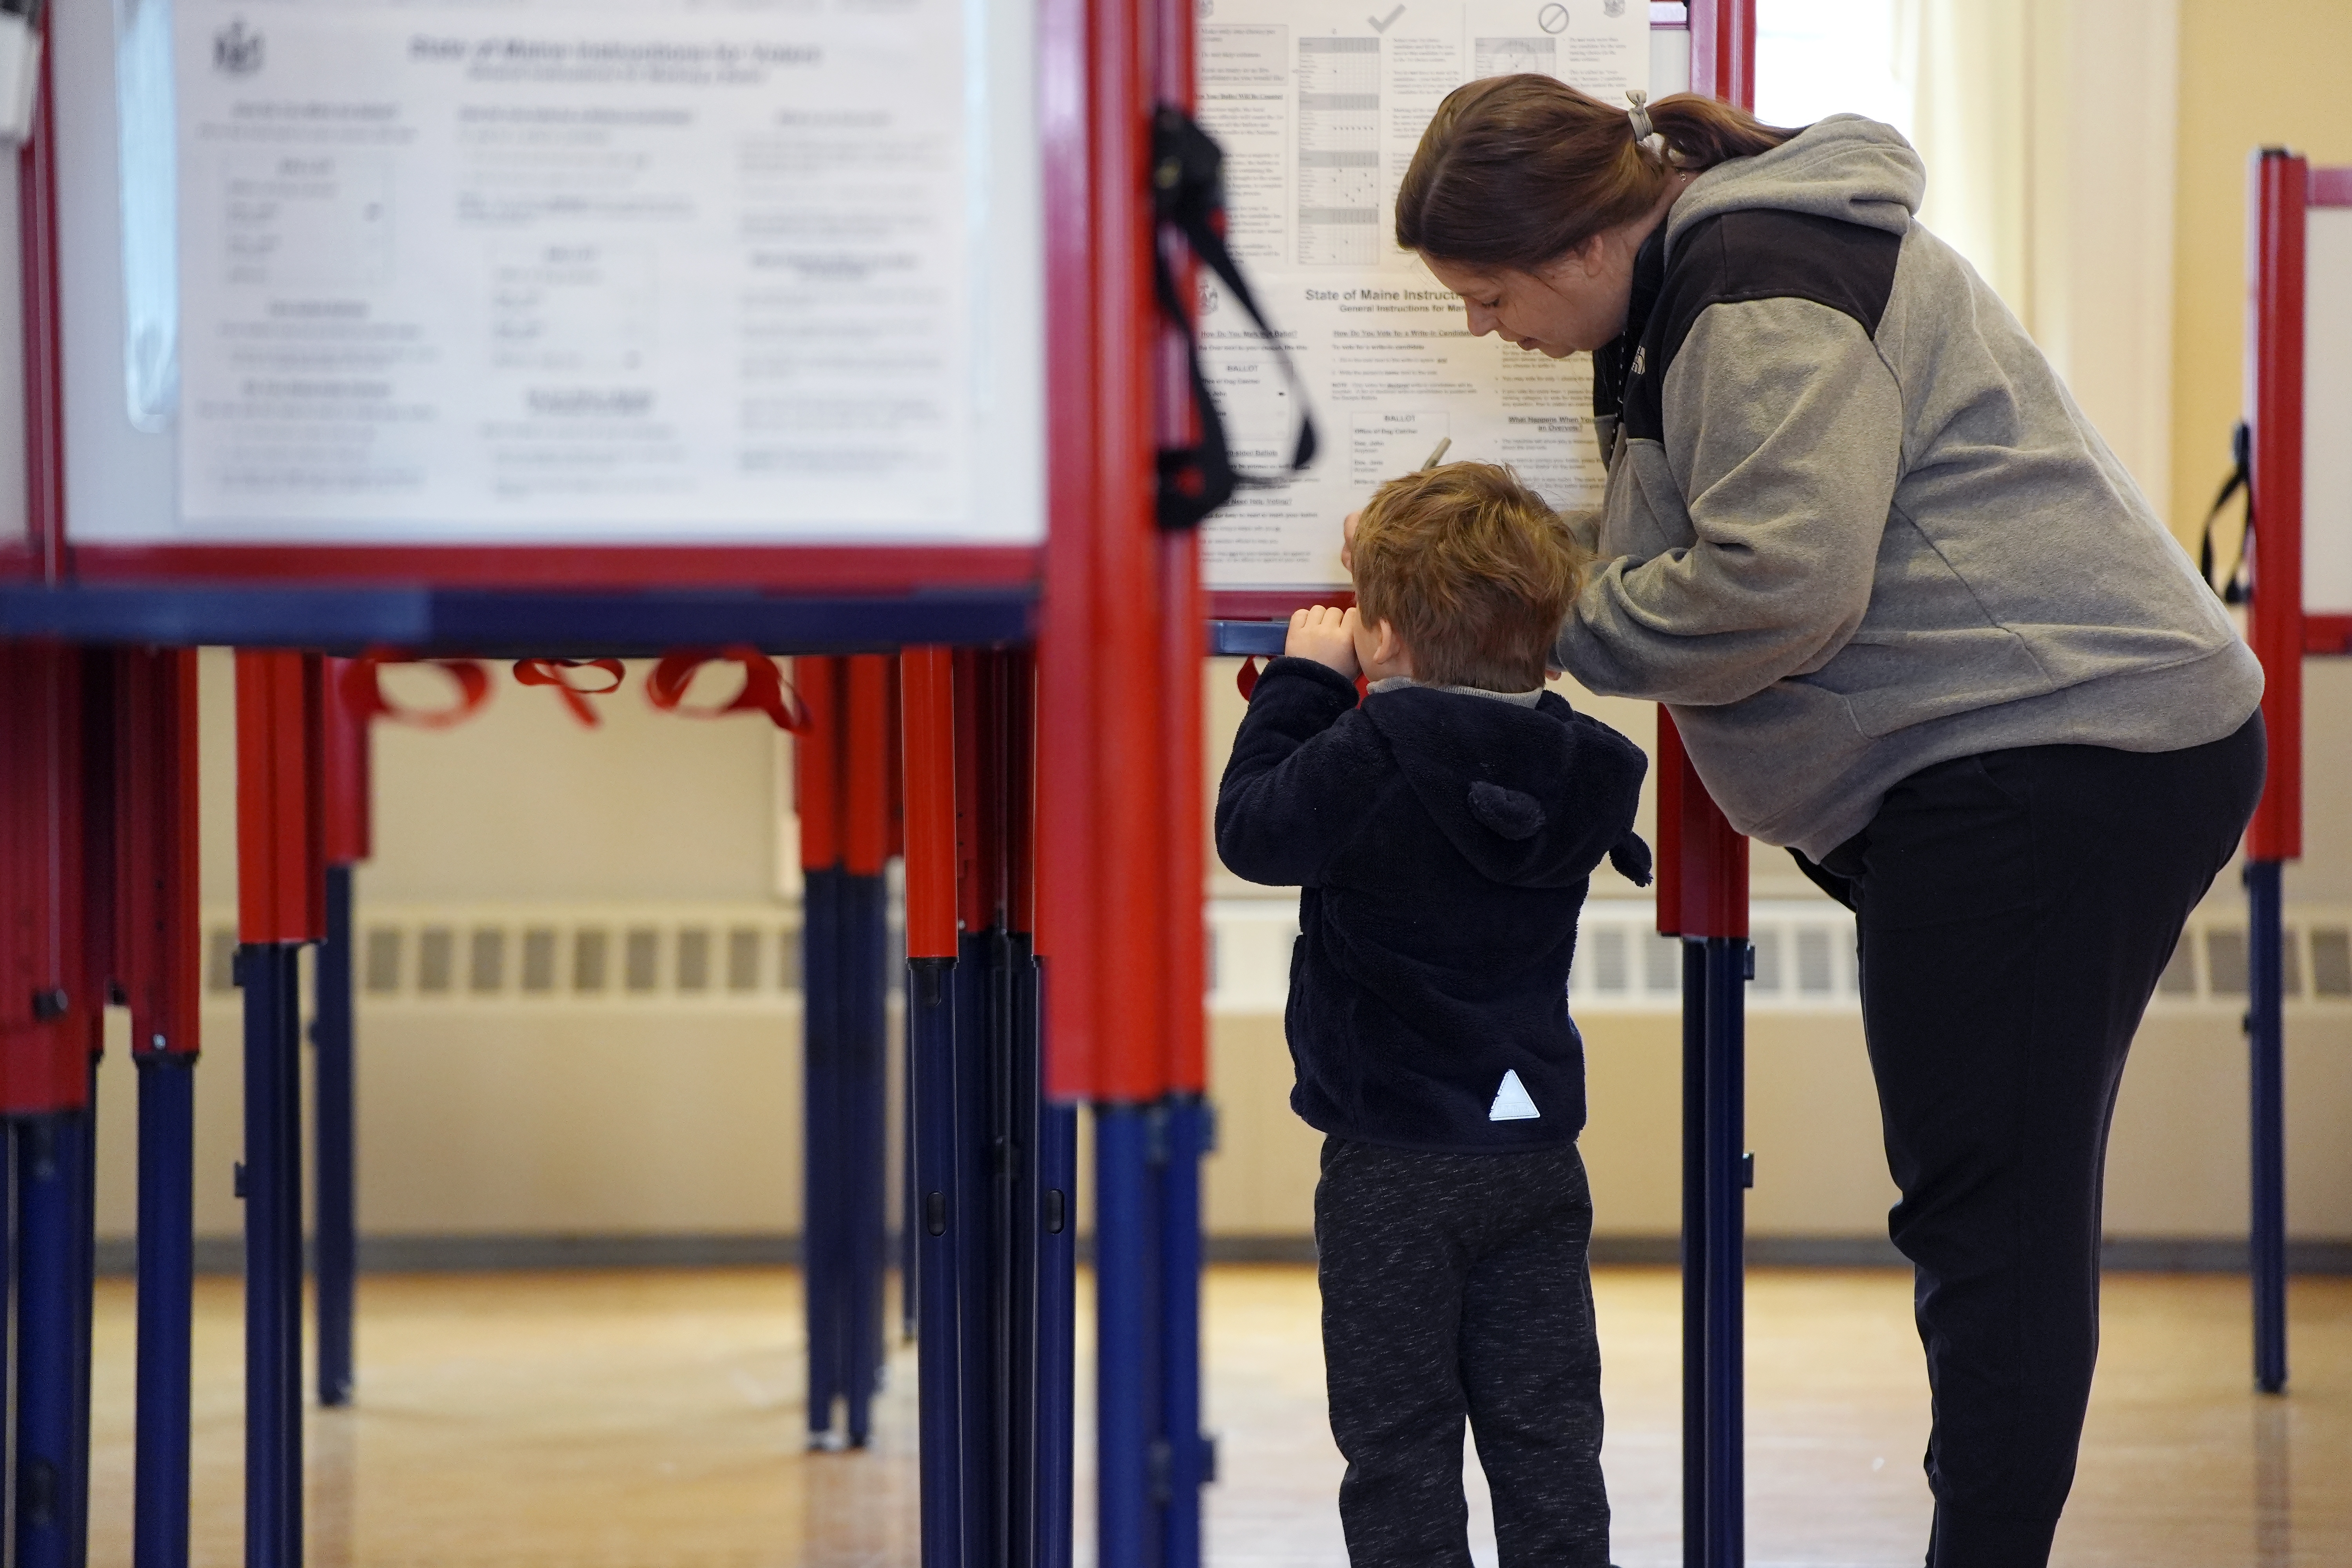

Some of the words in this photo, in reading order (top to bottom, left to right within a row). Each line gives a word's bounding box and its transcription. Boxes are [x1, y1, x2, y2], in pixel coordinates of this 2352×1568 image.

[1305, 289, 1339, 301] State
[1343, 289, 1357, 301] of
[1361, 289, 1400, 301] Maine
